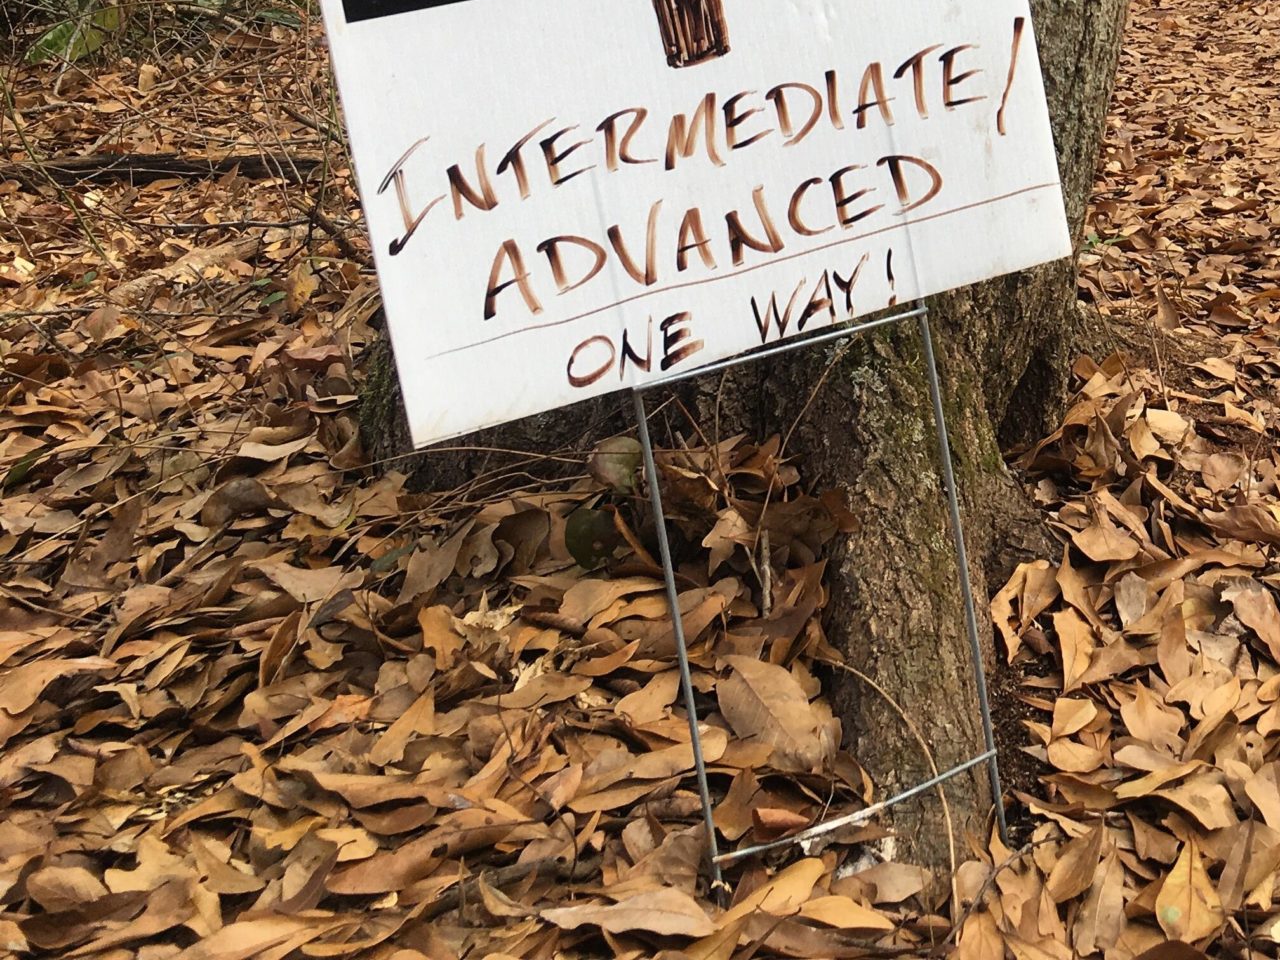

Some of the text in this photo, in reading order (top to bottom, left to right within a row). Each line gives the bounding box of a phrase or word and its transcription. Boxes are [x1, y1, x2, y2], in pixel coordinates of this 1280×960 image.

[483, 154, 944, 321] ADVANCED
[565, 247, 899, 388] ONE WAY!
